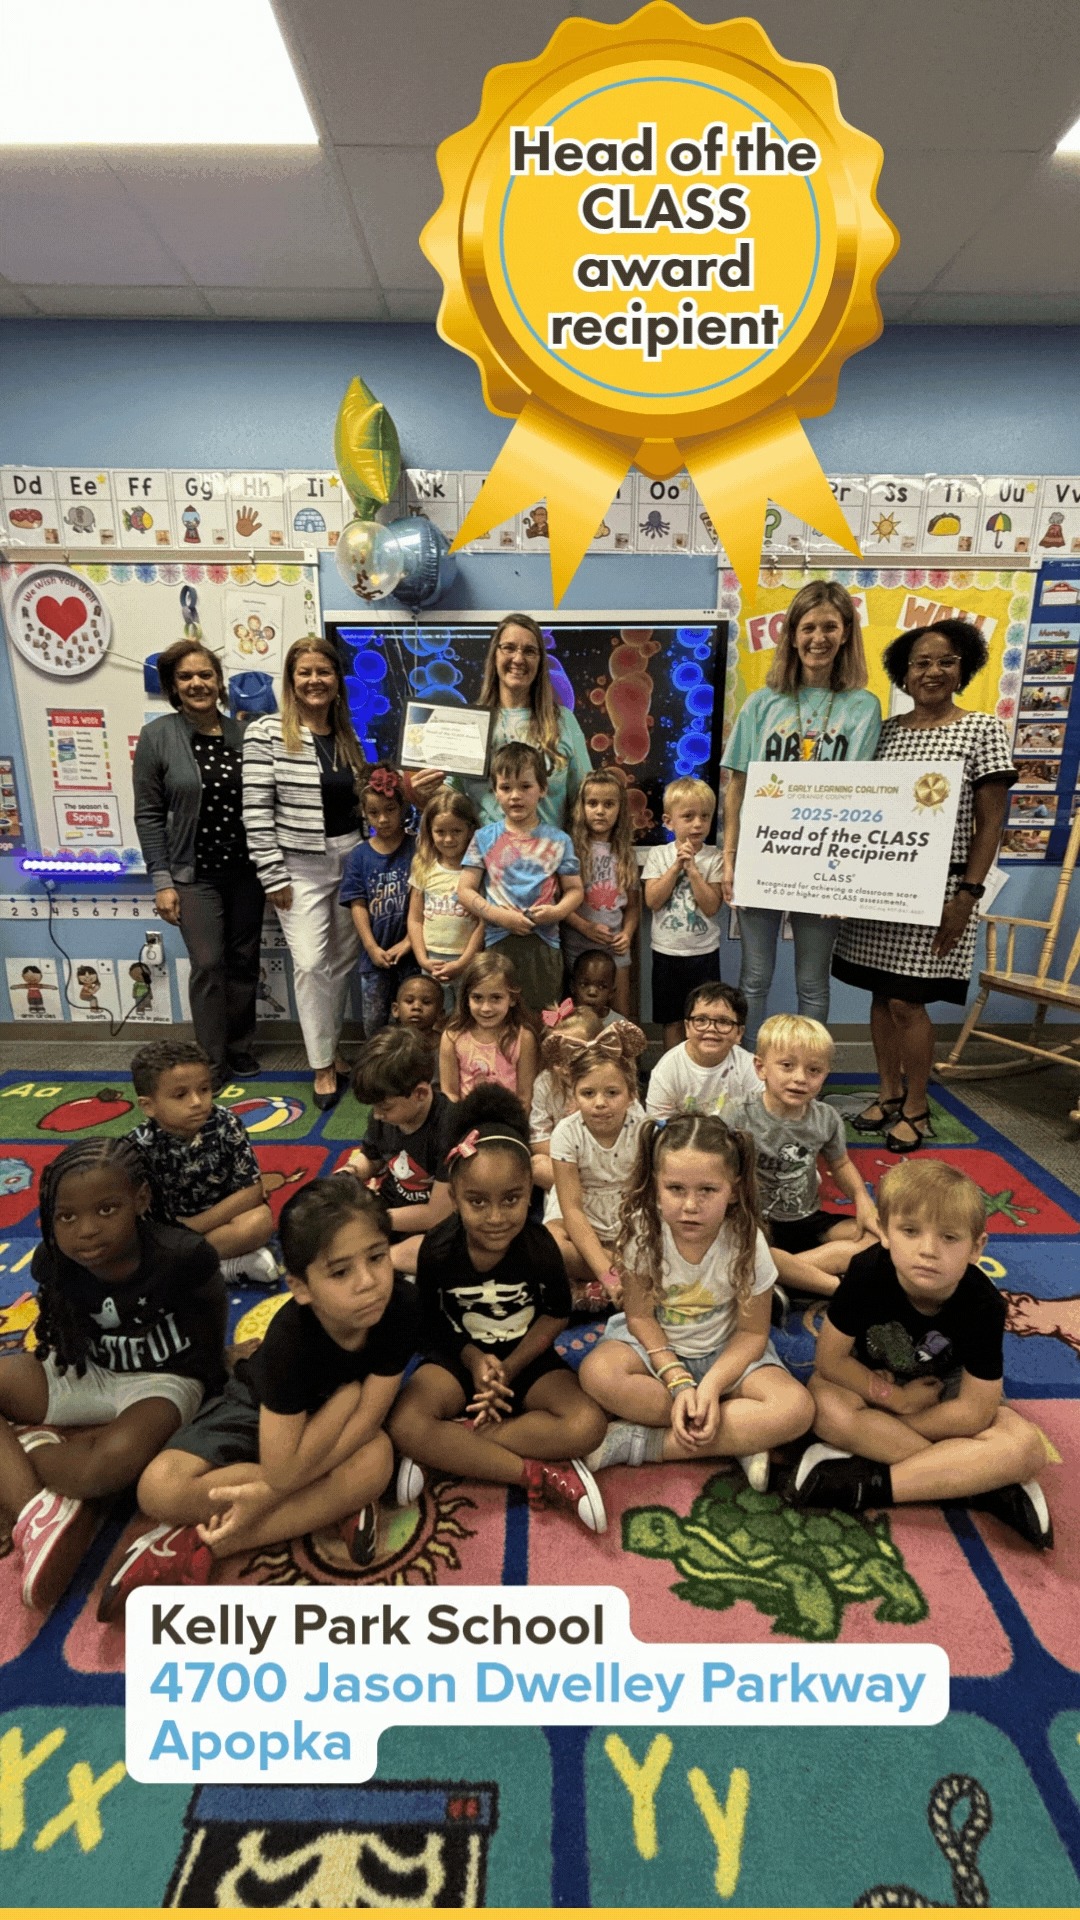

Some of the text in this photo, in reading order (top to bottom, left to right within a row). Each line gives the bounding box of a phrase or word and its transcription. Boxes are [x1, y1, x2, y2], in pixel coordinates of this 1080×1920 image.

[13, 475, 42, 495] Dd
[69, 476, 97, 495] Ee
[128, 477, 152, 496] Ff
[185, 477, 213, 501] Gg
[243, 477, 270, 497] Hh
[307, 477, 324, 497] Ii
[650, 481, 680, 500] Oo
[884, 480, 908, 502] Ss
[999, 481, 1024, 503] Uu
[23, 577, 97, 603] We Wish You Well
[788, 785, 899, 794] EARLY LEARNING COALITION
[72, 812, 103, 824] Spring
[791, 807, 883, 822] 2025-2026
[756, 825, 930, 847] Head of the CLASS
[762, 841, 918, 864] Award Recipient
[378, 871, 398, 882] THIS
[375, 882, 405, 900] GIRL
[757, 880, 797, 889] Recognized
[811, 883, 846, 894] achieving
[855, 887, 893, 897] classroom
[796, 890, 819, 899] higher
[833, 893, 857, 902] CLASS
[860, 897, 908, 907] assessments.
[11, 907, 19, 916] 2
[32, 908, 38, 916] 3
[51, 907, 59, 916] 4
[72, 907, 79, 916] 5
[92, 908, 99, 916] 6
[111, 908, 118, 916] 7
[132, 908, 139, 916] 8
[1, 1083, 62, 1097] Aa
[604, 1733, 750, 1898] Yy
